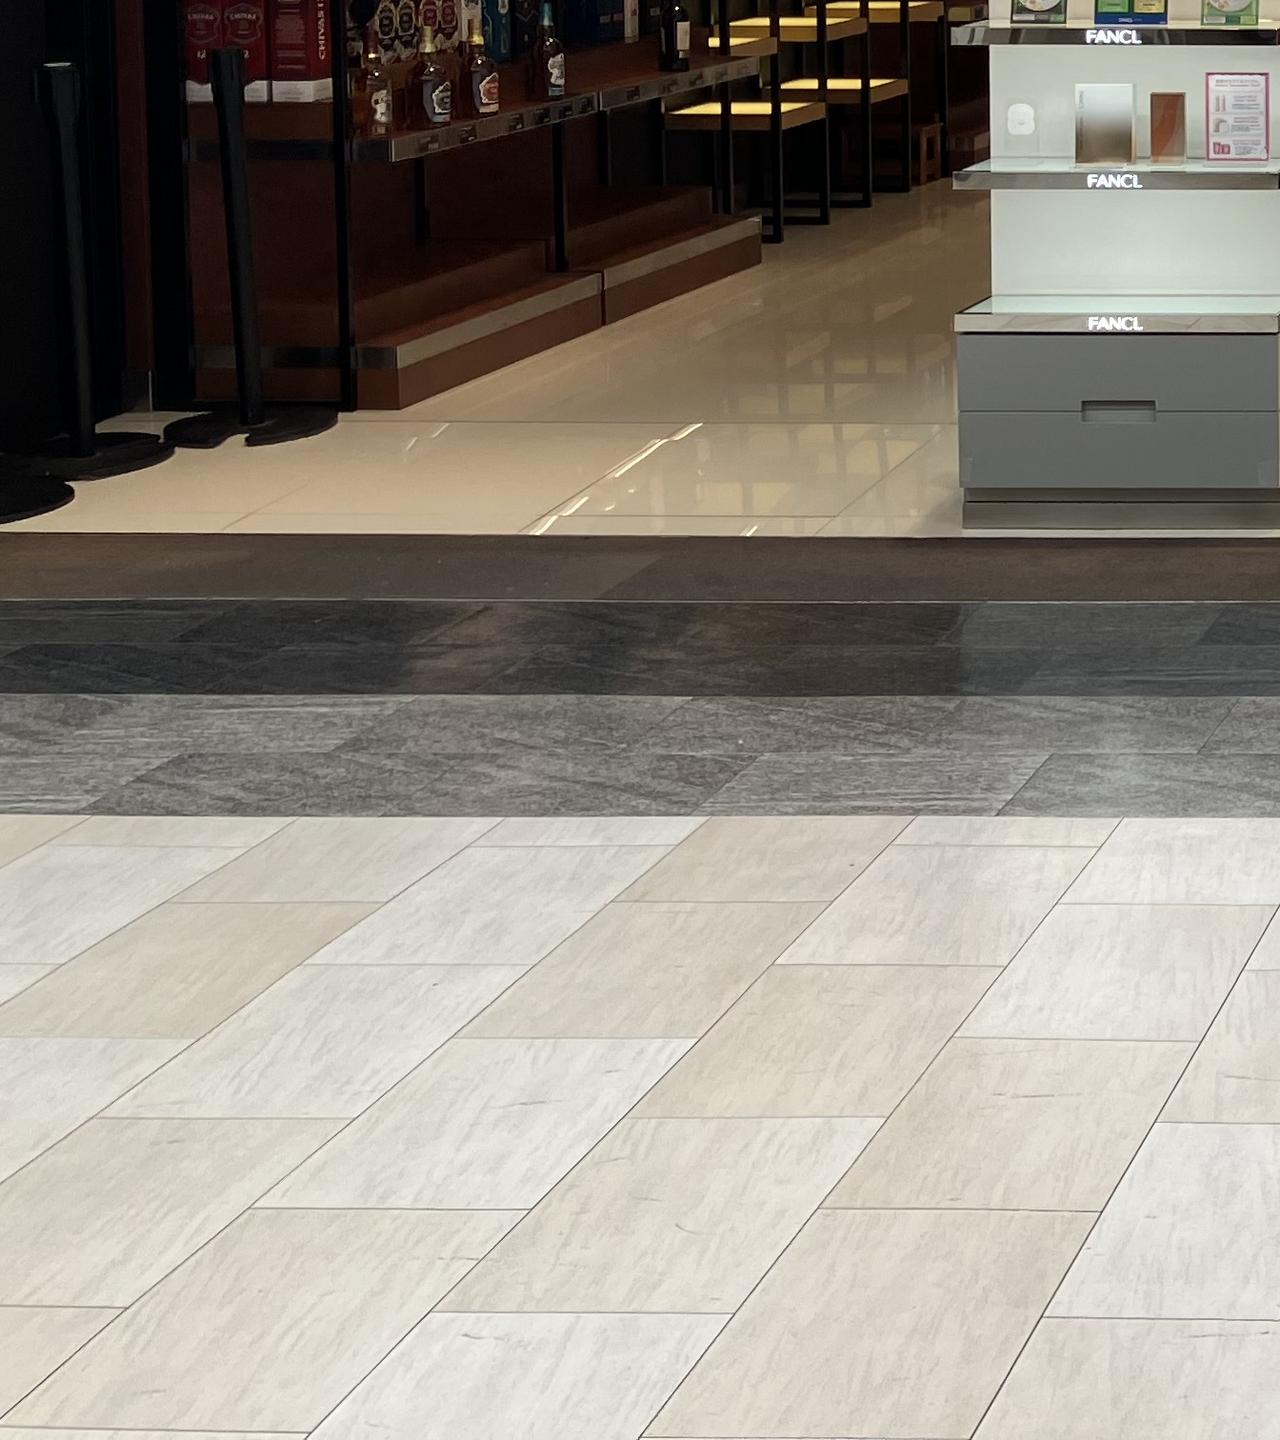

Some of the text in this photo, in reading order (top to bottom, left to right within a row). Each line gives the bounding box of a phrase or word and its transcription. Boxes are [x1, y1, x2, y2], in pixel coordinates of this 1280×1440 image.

[317, 13, 326, 60] CHIVAS
[1085, 29, 1142, 45] FANCL
[1086, 173, 1143, 188] FANCL
[1088, 316, 1143, 331] FANCL
